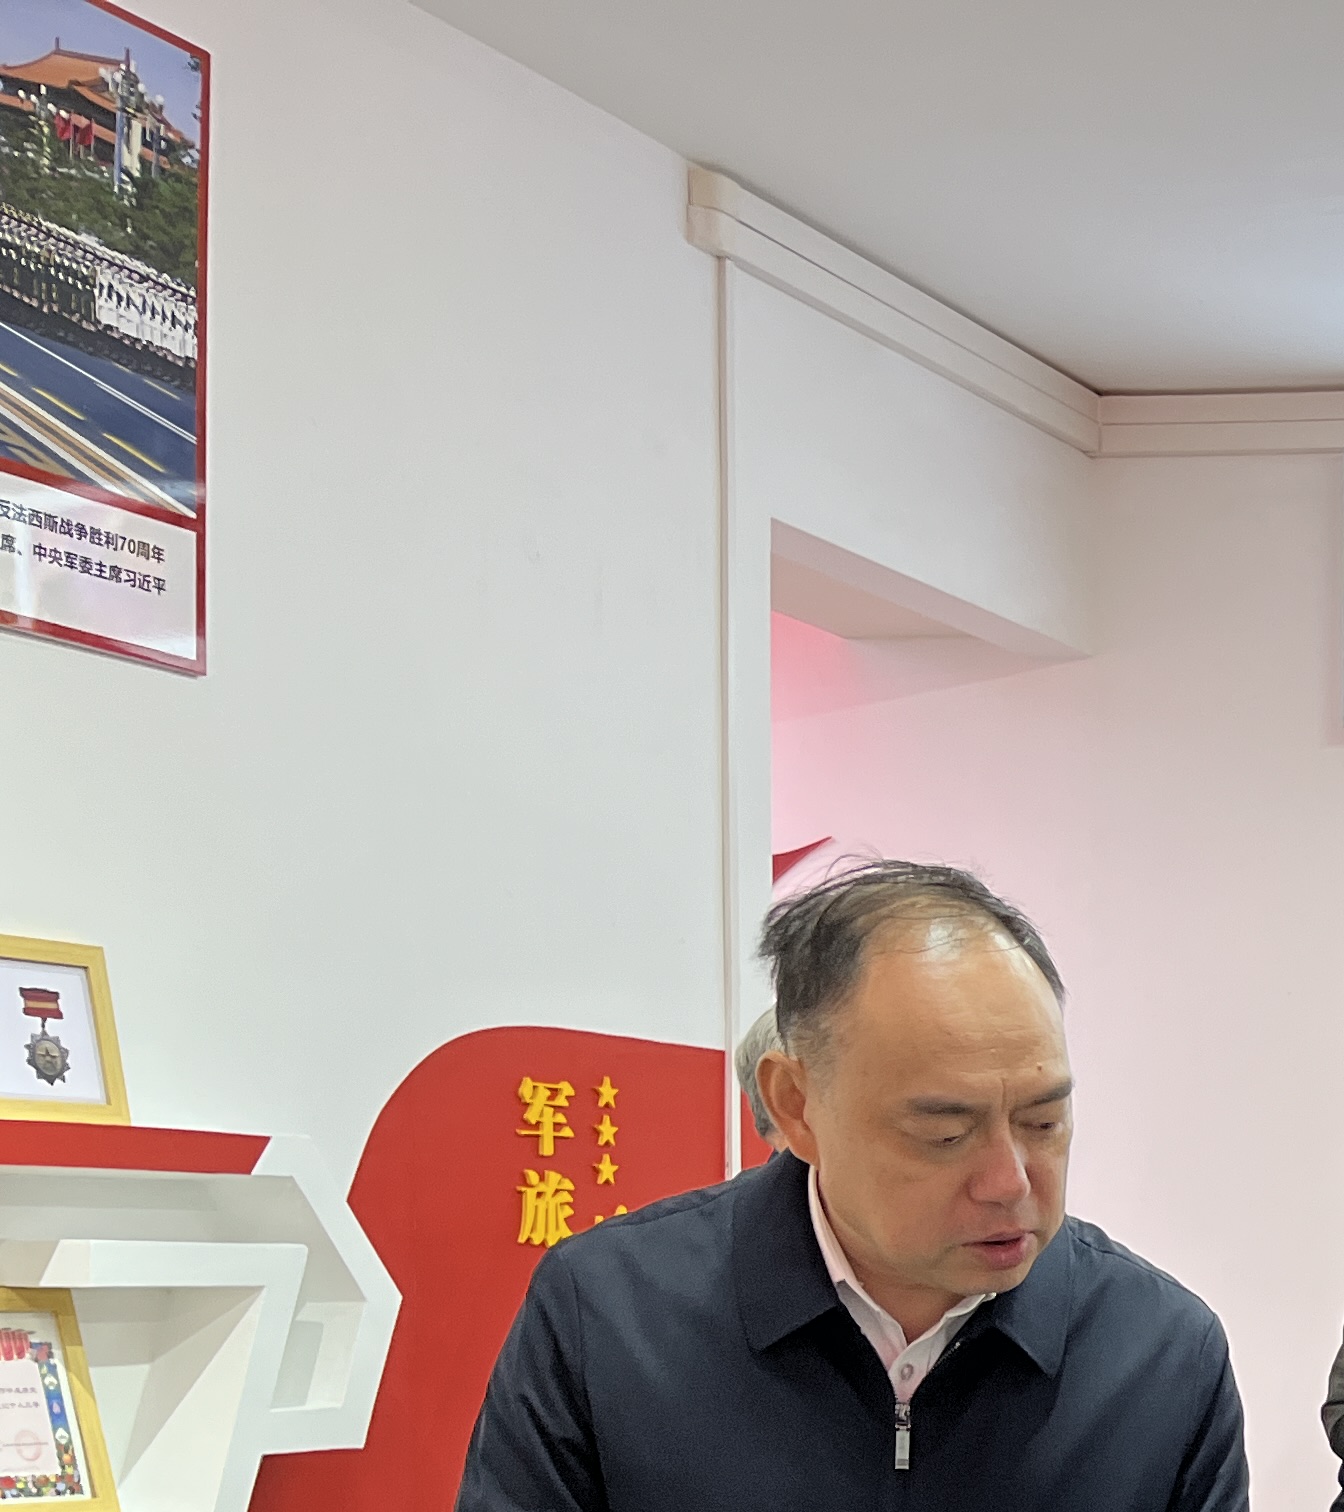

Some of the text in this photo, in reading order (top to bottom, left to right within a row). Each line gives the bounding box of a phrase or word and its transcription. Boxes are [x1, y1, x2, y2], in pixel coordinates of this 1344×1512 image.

[0, 500, 165, 564] 反法西斯战争胜利70周年
[516, 1076, 575, 1248] 军旅
